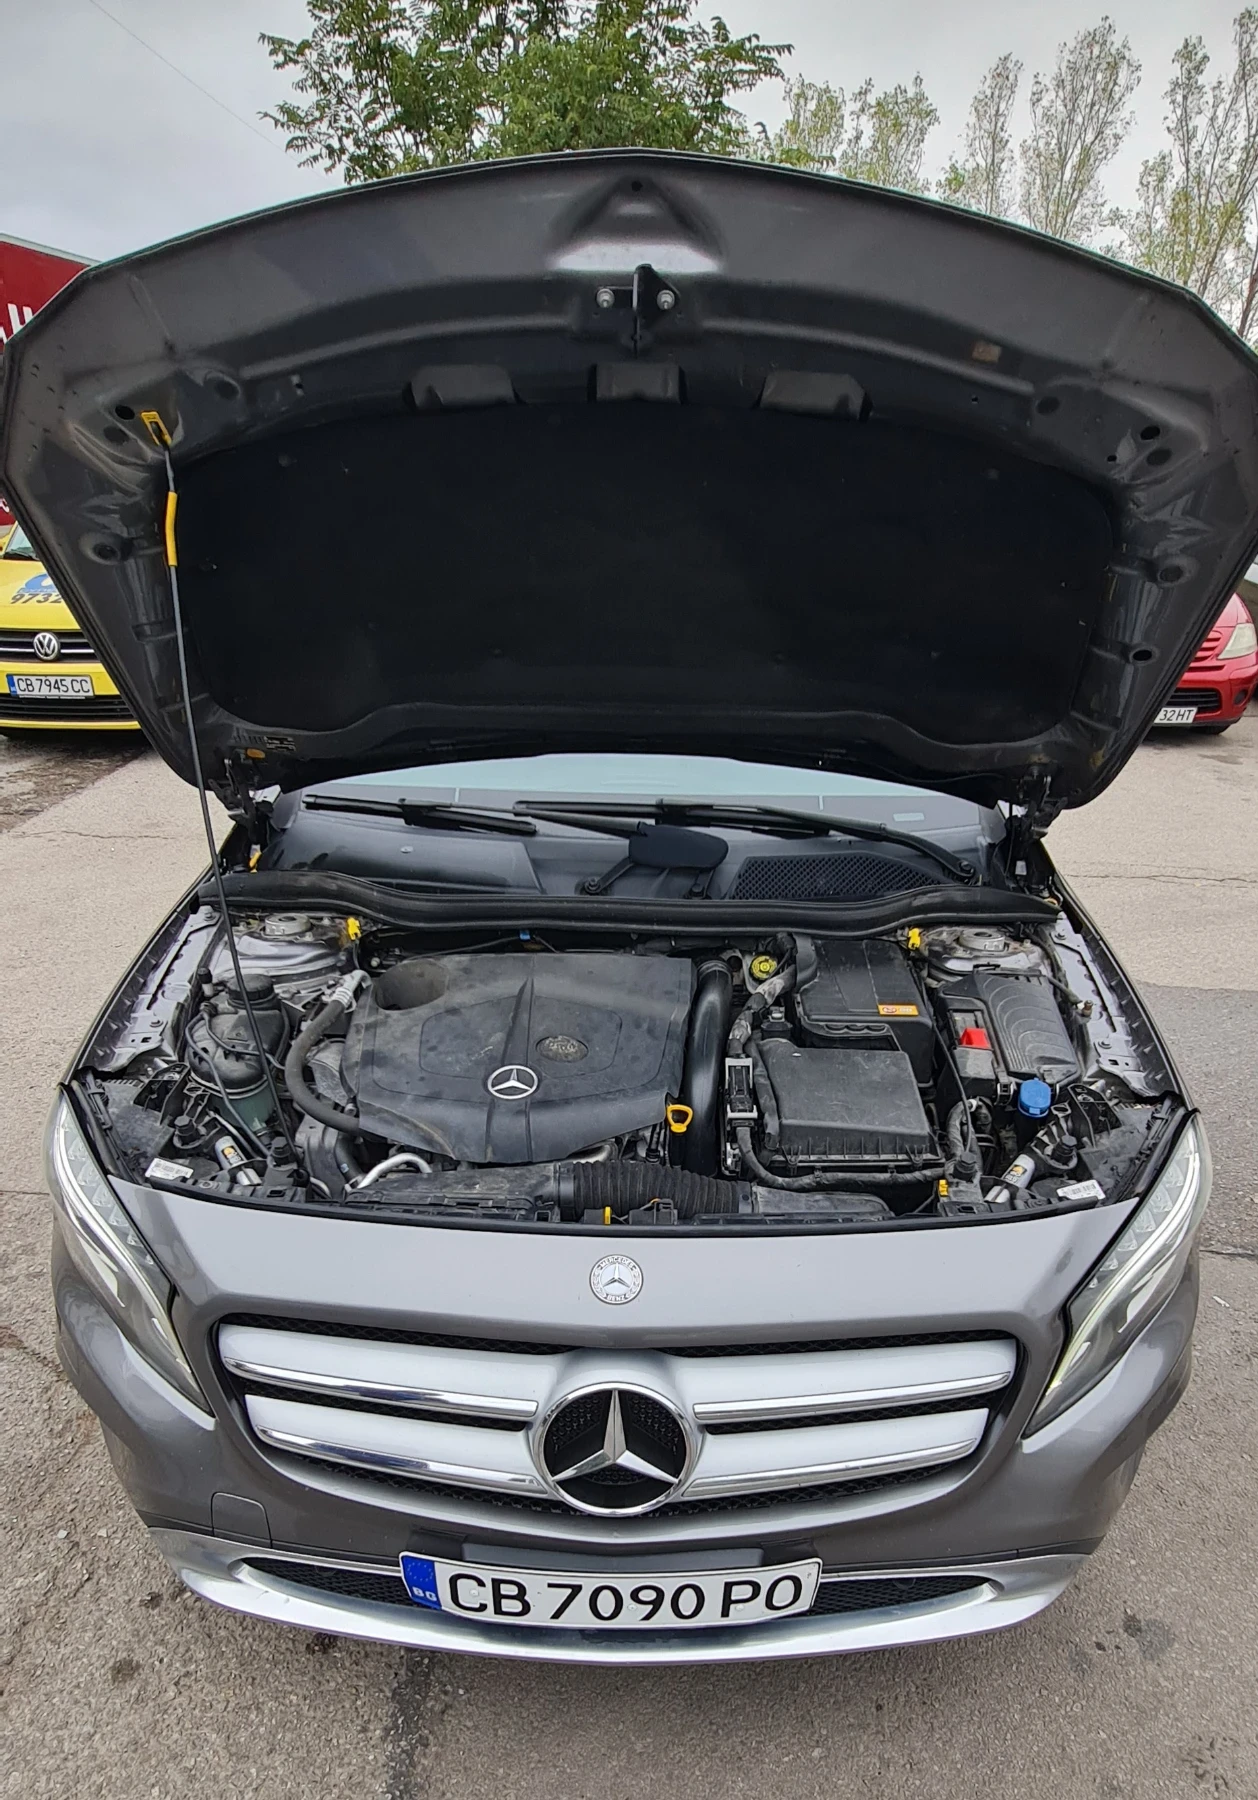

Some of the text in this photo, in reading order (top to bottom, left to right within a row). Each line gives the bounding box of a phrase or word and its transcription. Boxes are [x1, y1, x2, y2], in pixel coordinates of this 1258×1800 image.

[17, 677, 90, 693] CB 7945 CC
[1159, 709, 1194, 721] 32 HT
[412, 1586, 438, 1601] BG
[448, 1572, 803, 1621] CB 7090 PO
